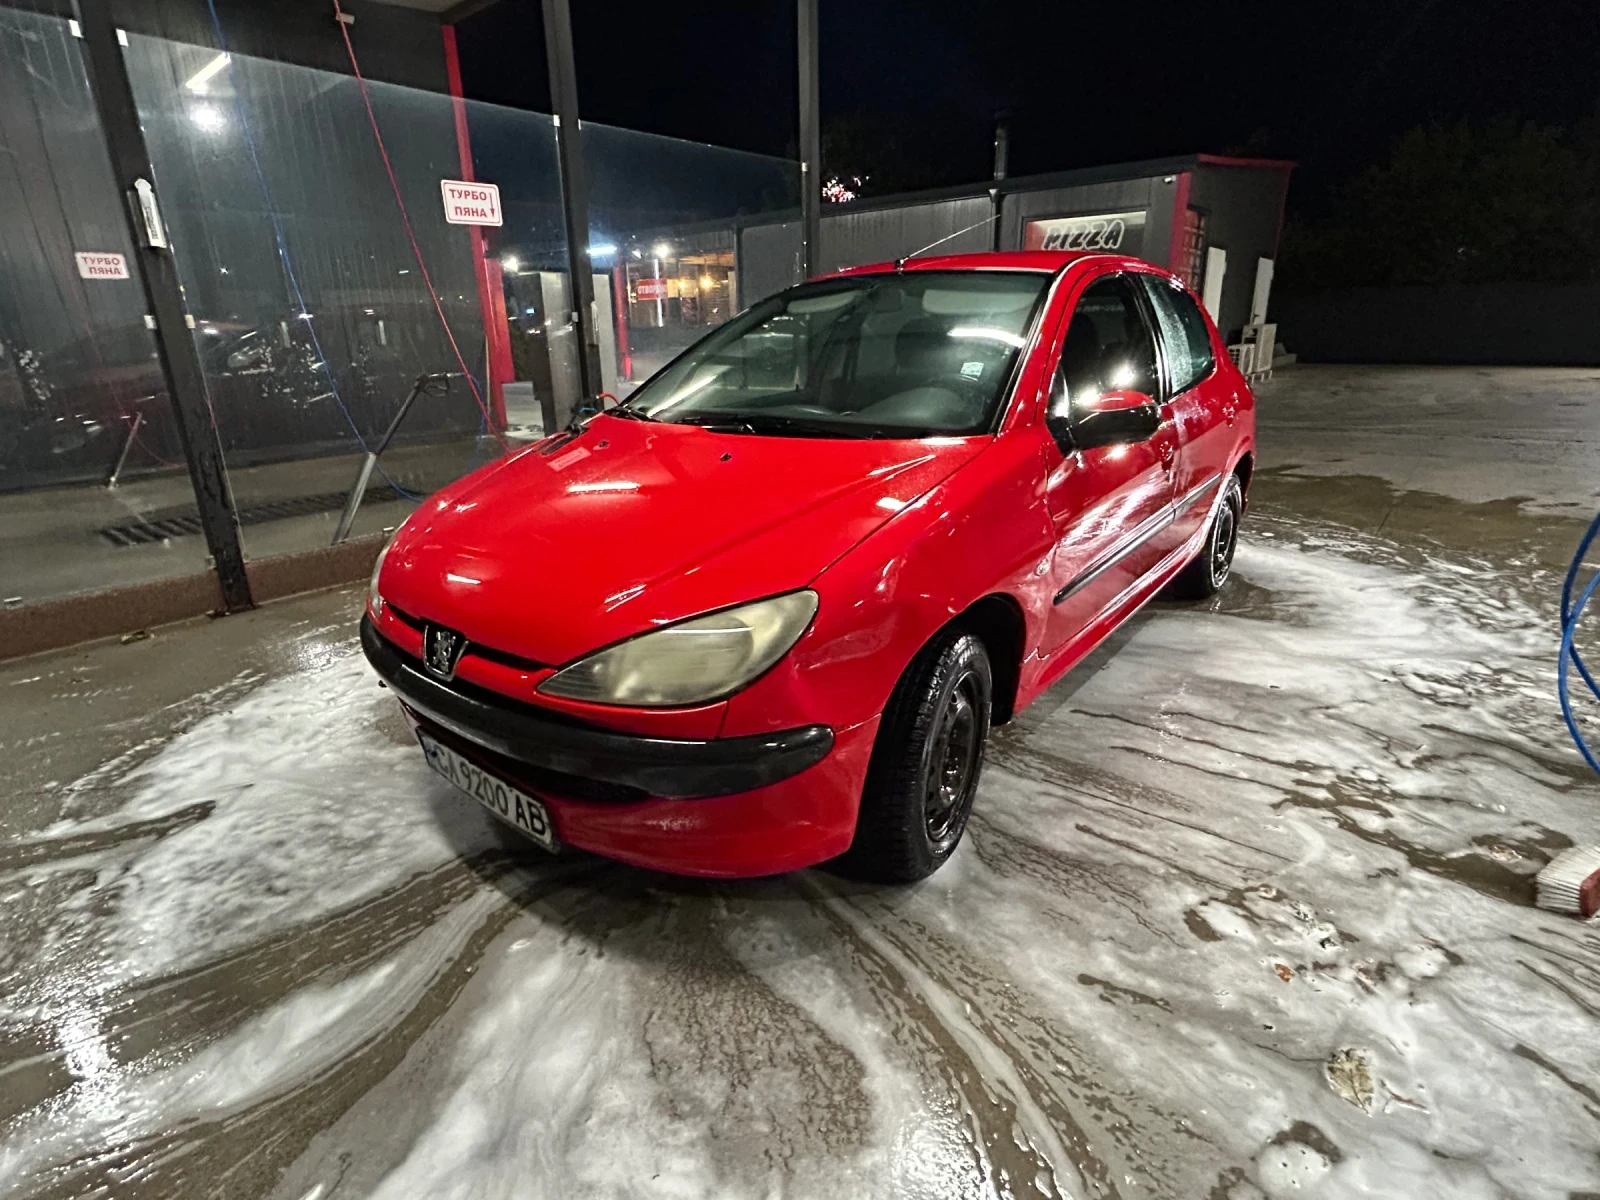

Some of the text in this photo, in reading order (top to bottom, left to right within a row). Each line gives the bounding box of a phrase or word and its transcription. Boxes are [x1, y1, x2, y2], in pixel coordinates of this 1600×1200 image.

[449, 188, 487, 201] ТУРБО
[454, 206, 487, 218] ПЯНА
[1042, 219, 1125, 250] PIZZA
[81, 256, 120, 266] ТУРБО
[89, 266, 121, 275] ПЯНА
[460, 761, 509, 817] 9200
[515, 794, 546, 836] AB
